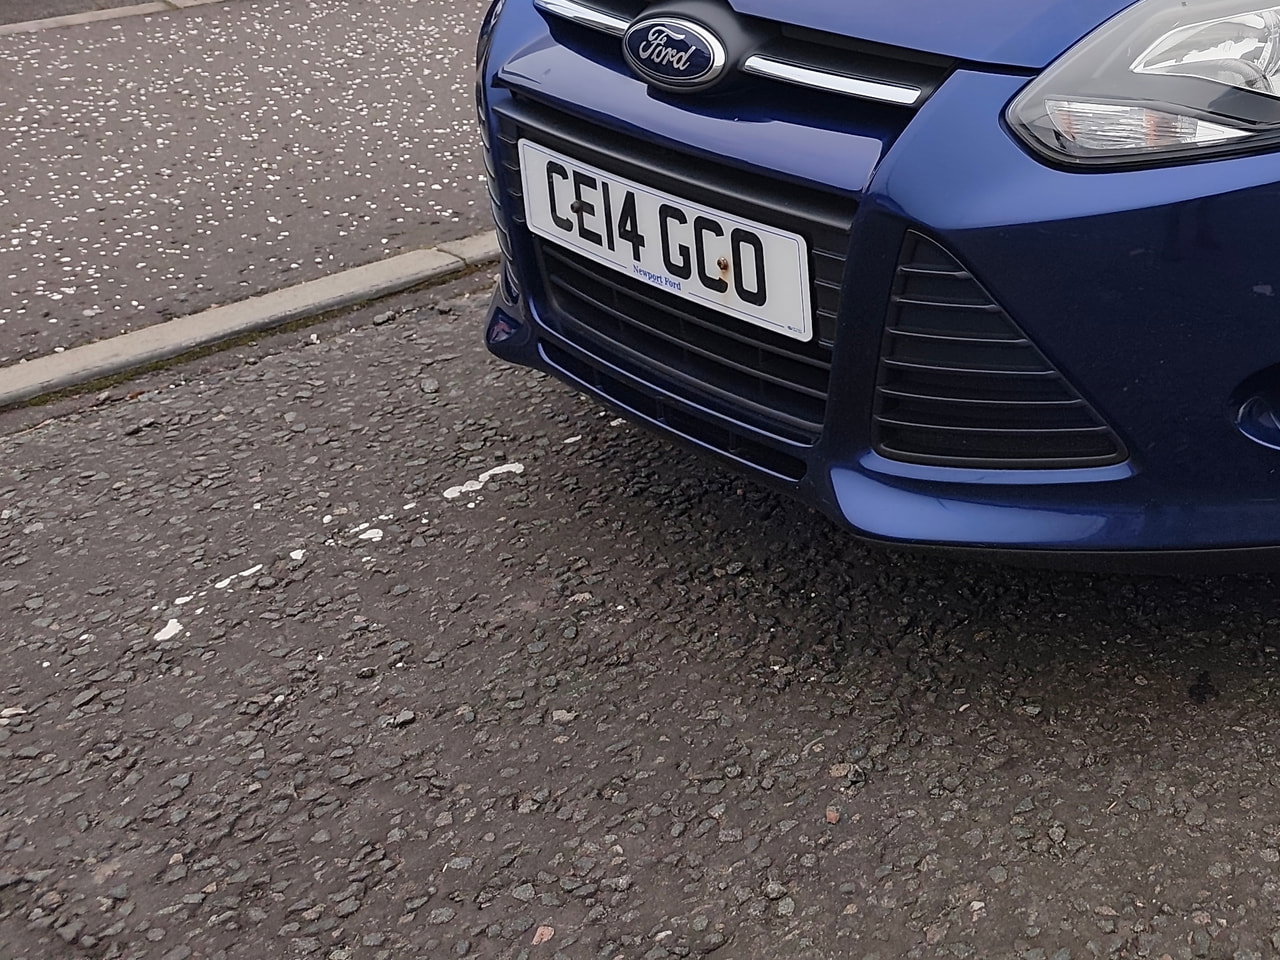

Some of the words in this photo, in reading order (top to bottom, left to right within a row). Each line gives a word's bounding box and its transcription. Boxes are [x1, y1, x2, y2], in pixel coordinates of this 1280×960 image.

[638, 25, 697, 72] Ford
[546, 160, 646, 263] CE14
[658, 203, 767, 307] GCO
[633, 263, 664, 286] Newport
[664, 276, 682, 291] Ford
